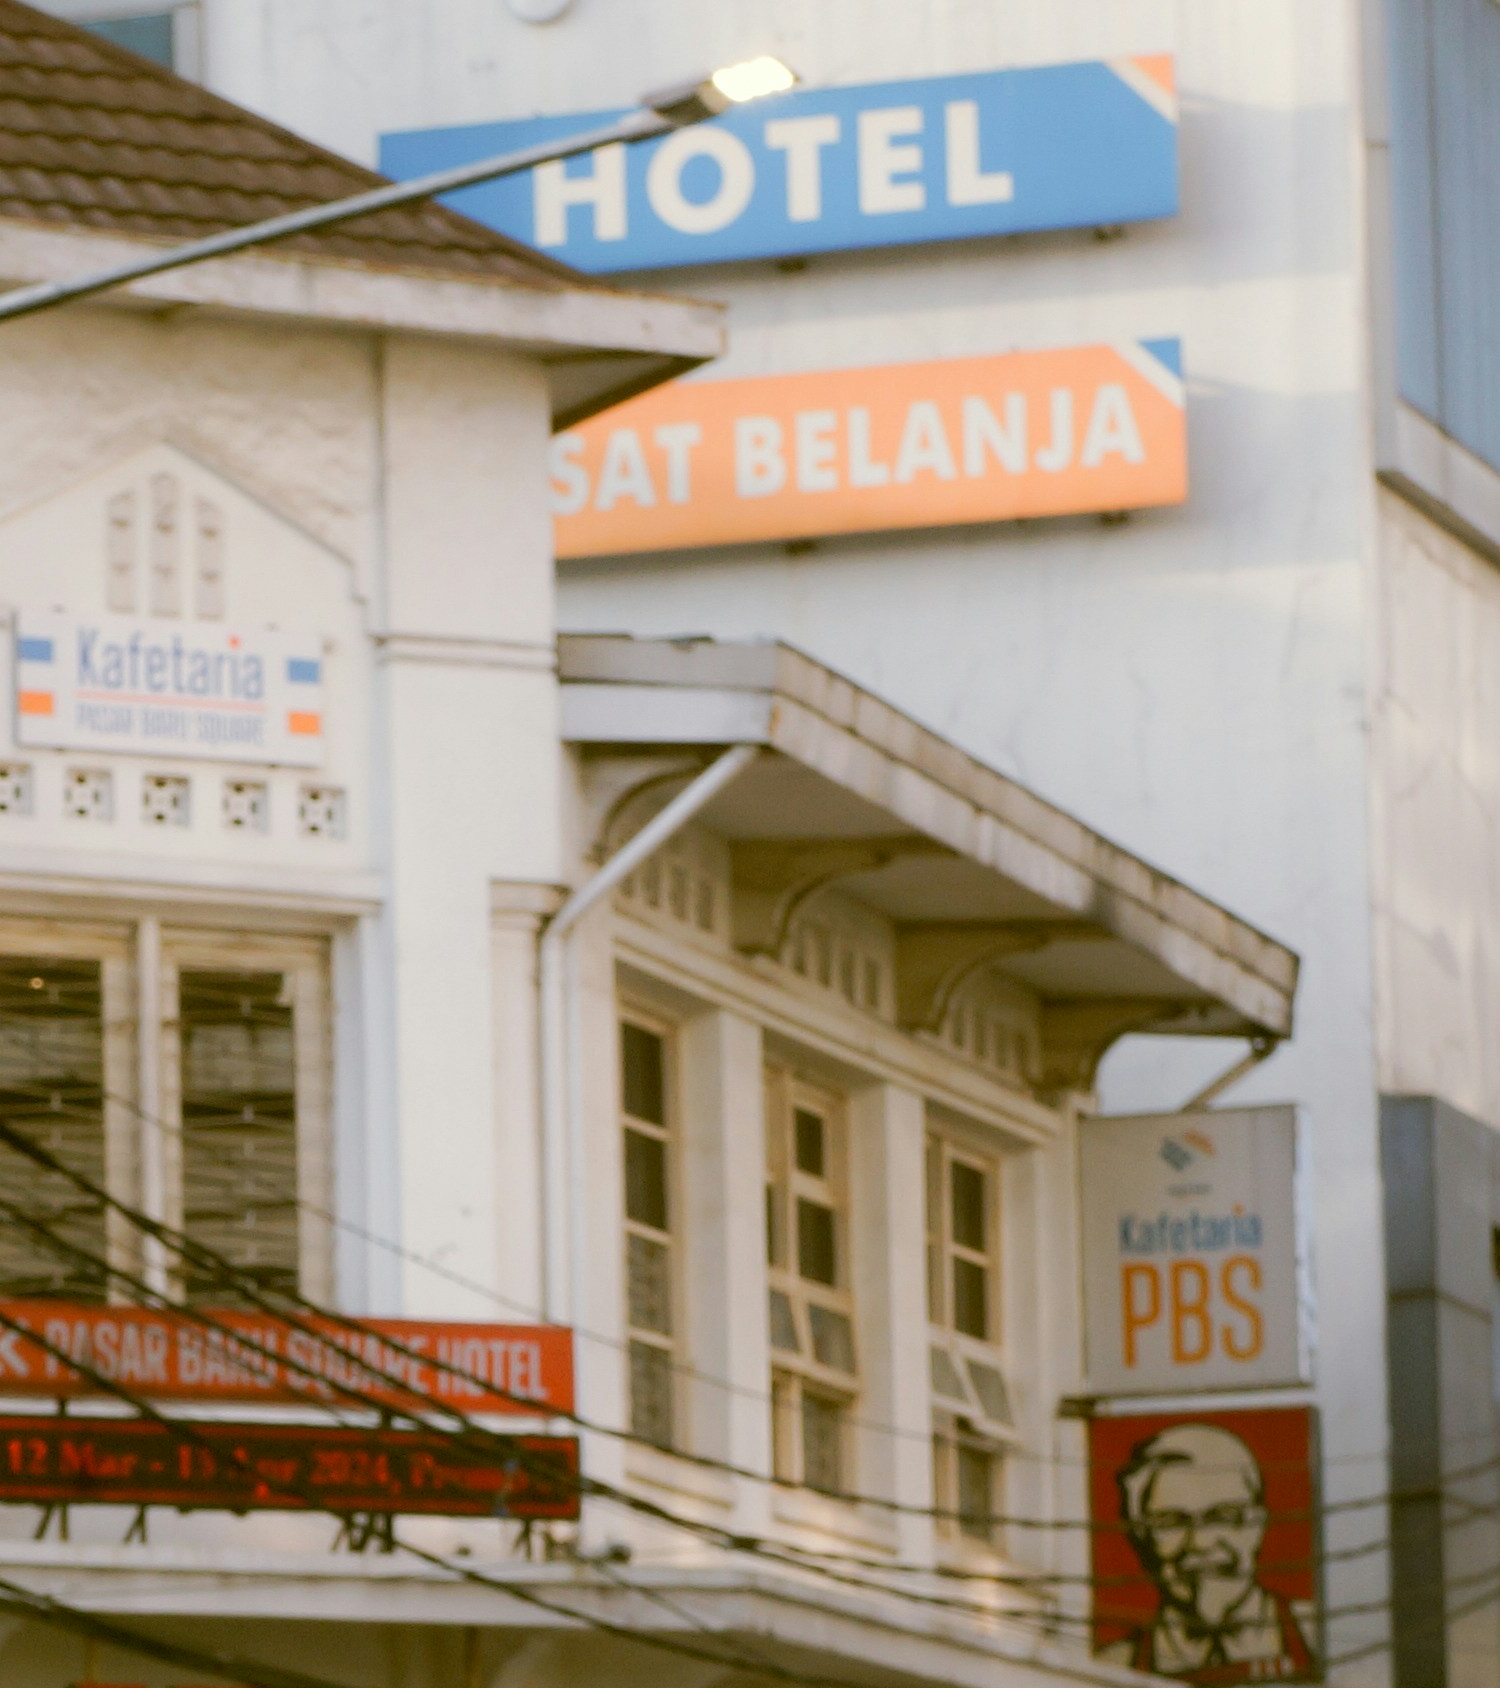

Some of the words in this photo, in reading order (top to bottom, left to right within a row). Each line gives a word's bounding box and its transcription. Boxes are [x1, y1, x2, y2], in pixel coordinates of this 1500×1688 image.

[534, 101, 1013, 247] HOTEL
[735, 383, 1146, 499] BELANJA
[78, 624, 266, 701] Kafetaria
[1119, 1204, 1263, 1255] Kafetaria
[1120, 1255, 1265, 1369] PBS
[44, 1317, 169, 1383] PASAR
[437, 1335, 550, 1400] HOTEL
[8, 1438, 48, 1476] 12
